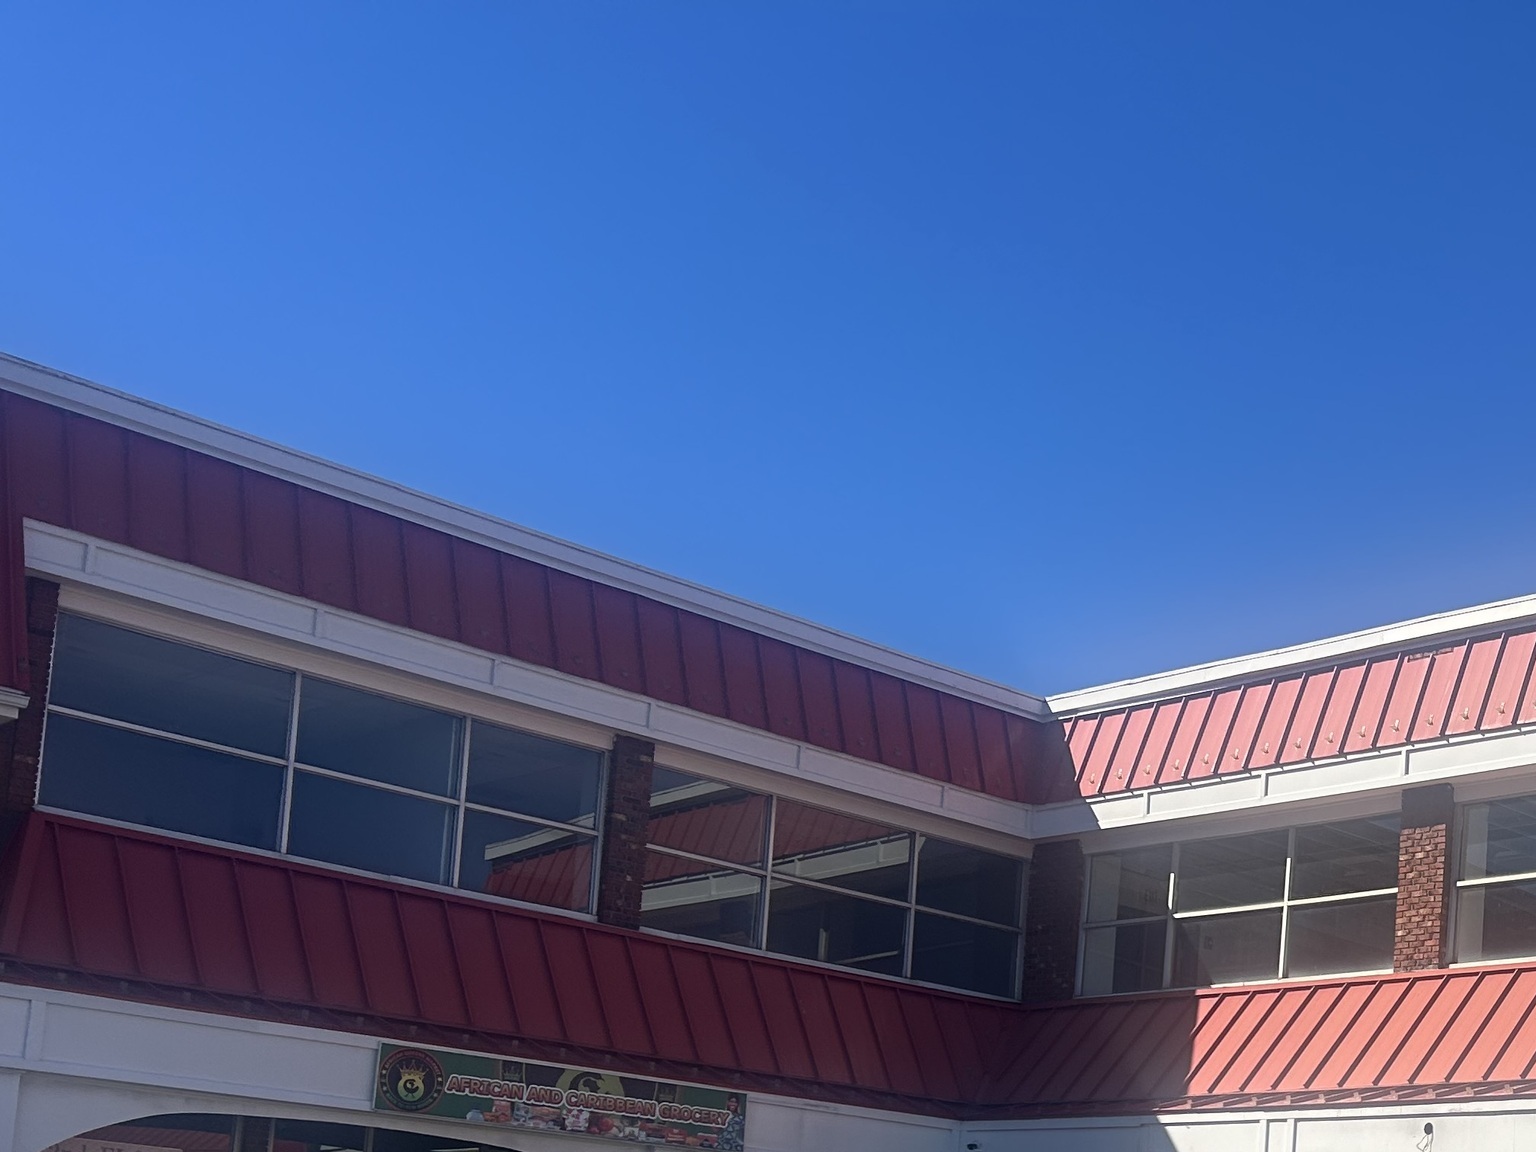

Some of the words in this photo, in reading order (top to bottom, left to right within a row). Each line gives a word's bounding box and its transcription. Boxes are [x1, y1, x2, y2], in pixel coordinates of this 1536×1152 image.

[447, 1075, 526, 1101] AFRICAN
[527, 1085, 563, 1107] AND
[566, 1091, 657, 1118] CARIBBEAN
[658, 1101, 731, 1127] GROCERY
